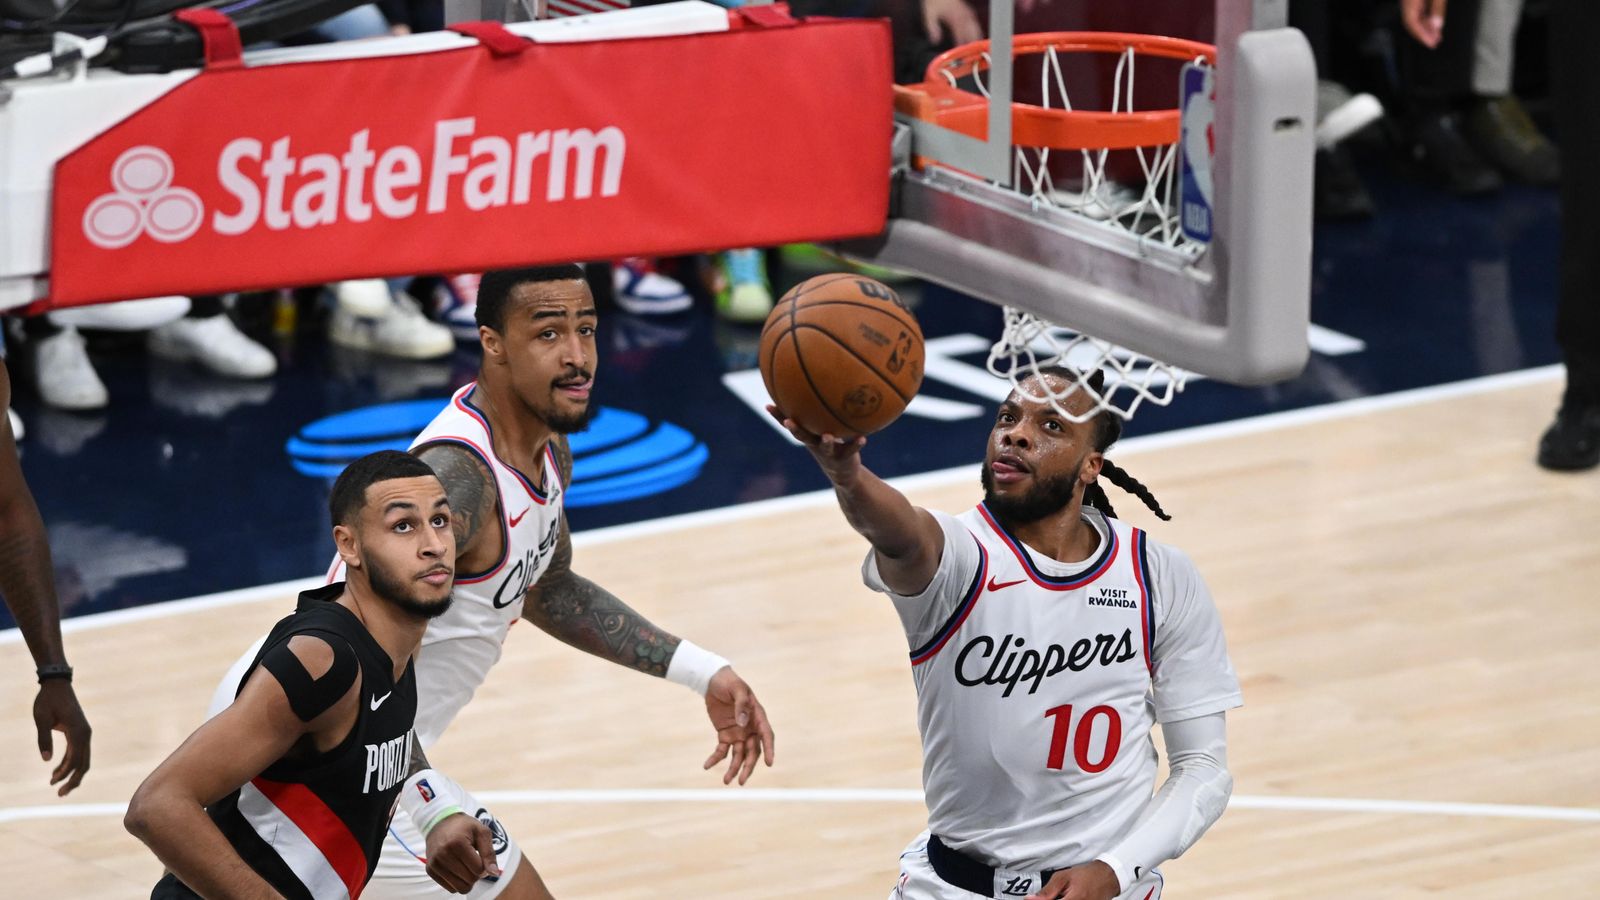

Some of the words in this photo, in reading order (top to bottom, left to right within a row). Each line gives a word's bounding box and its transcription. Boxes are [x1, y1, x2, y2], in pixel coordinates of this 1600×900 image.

[493, 506, 560, 609] Clier
[1088, 596, 1137, 608] RWANDA
[1100, 588, 1127, 598] VISIT
[954, 627, 1137, 698] Clippers
[362, 728, 414, 794] PORTLA
[1044, 704, 1122, 773] 10
[1002, 876, 1032, 896] LA
